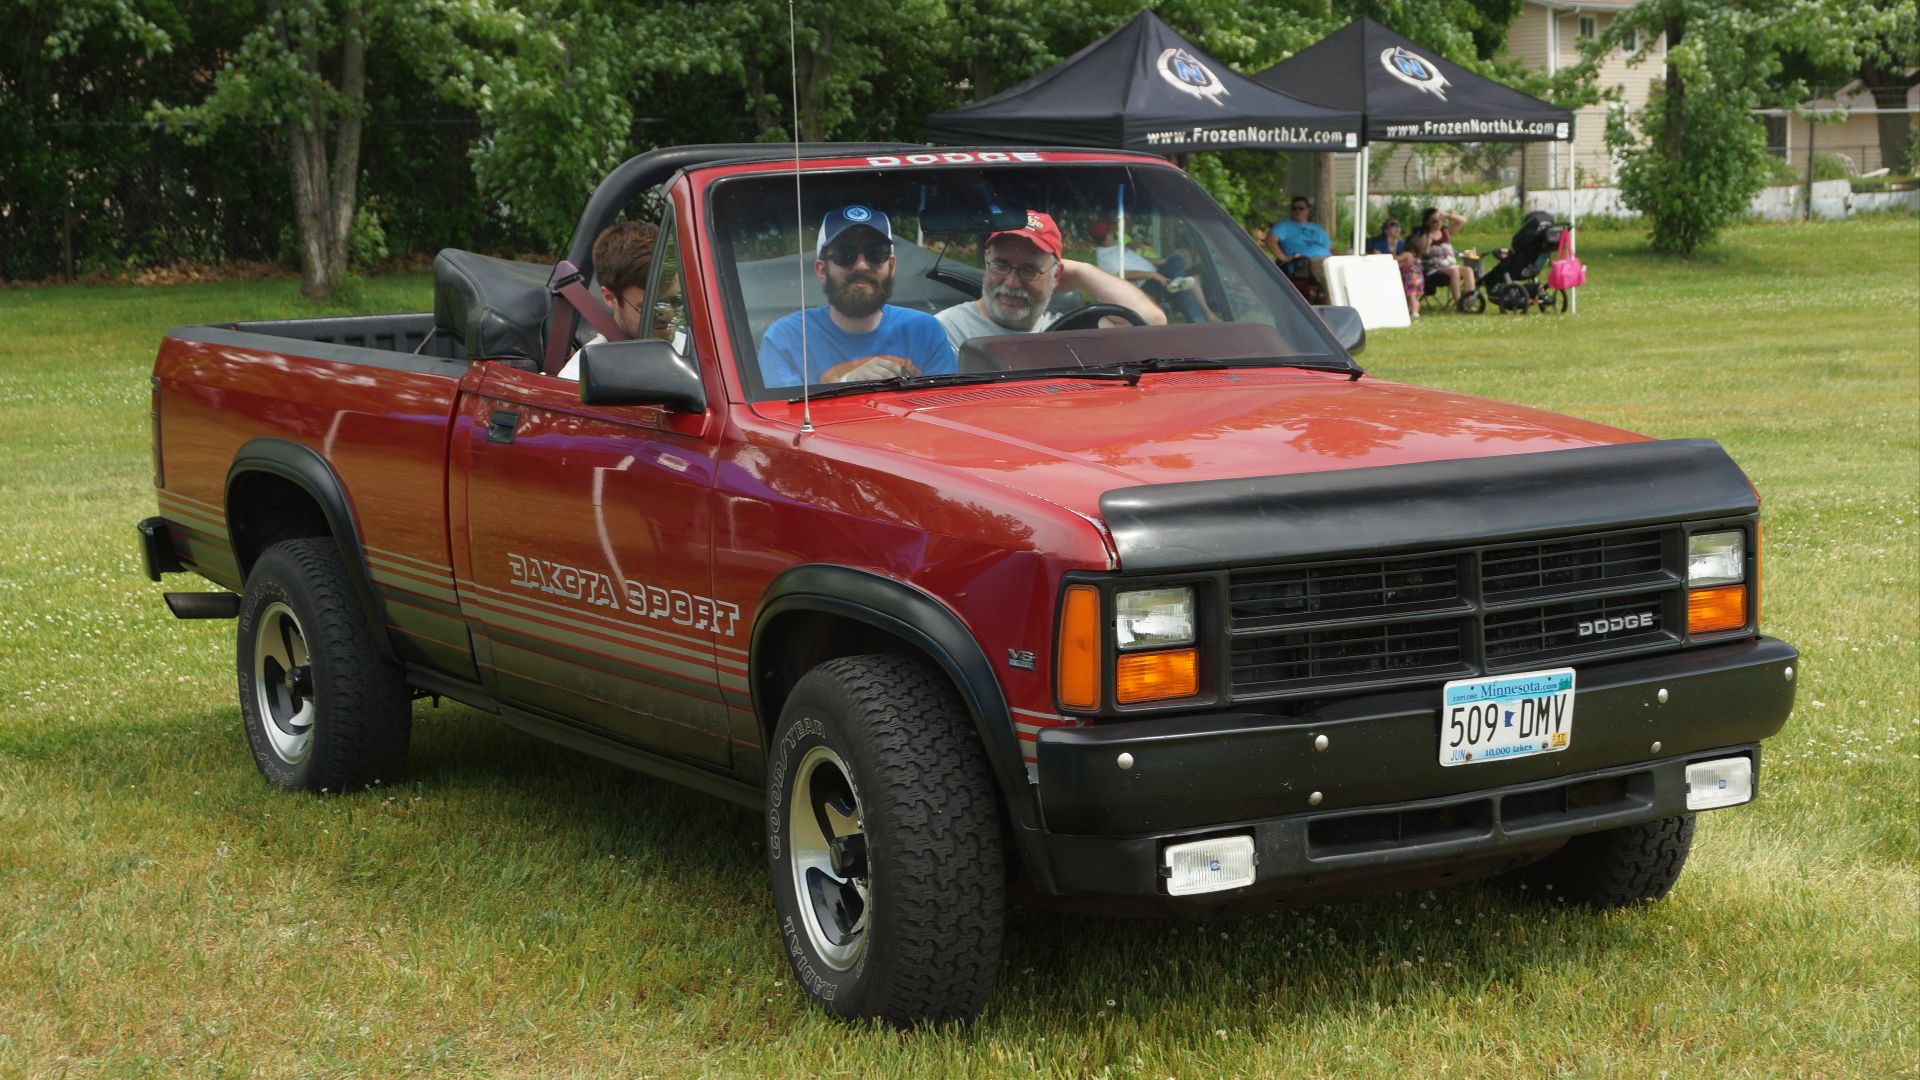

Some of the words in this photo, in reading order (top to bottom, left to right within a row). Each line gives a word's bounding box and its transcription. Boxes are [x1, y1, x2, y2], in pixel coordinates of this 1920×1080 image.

[1146, 126, 1343, 145] www.FrozenNorthLX.com
[1386, 118, 1554, 138] www.FrozenNorthLX.com
[866, 152, 1044, 167] DODGE
[507, 552, 620, 610] DAKOTA
[624, 579, 740, 637] SPORT
[1579, 612, 1654, 637] DODGE
[1453, 693, 1478, 702] EXPLORE
[1480, 681, 1558, 699] Minnesota.com
[1450, 703, 1499, 748] 509
[1519, 693, 1567, 739] DMV
[1450, 748, 1466, 761] JUN
[1485, 746, 1511, 757] 10,000
[1512, 744, 1533, 753] lakes
[770, 717, 827, 860] GOODYEAR
[786, 915, 838, 1002] RADIAL
